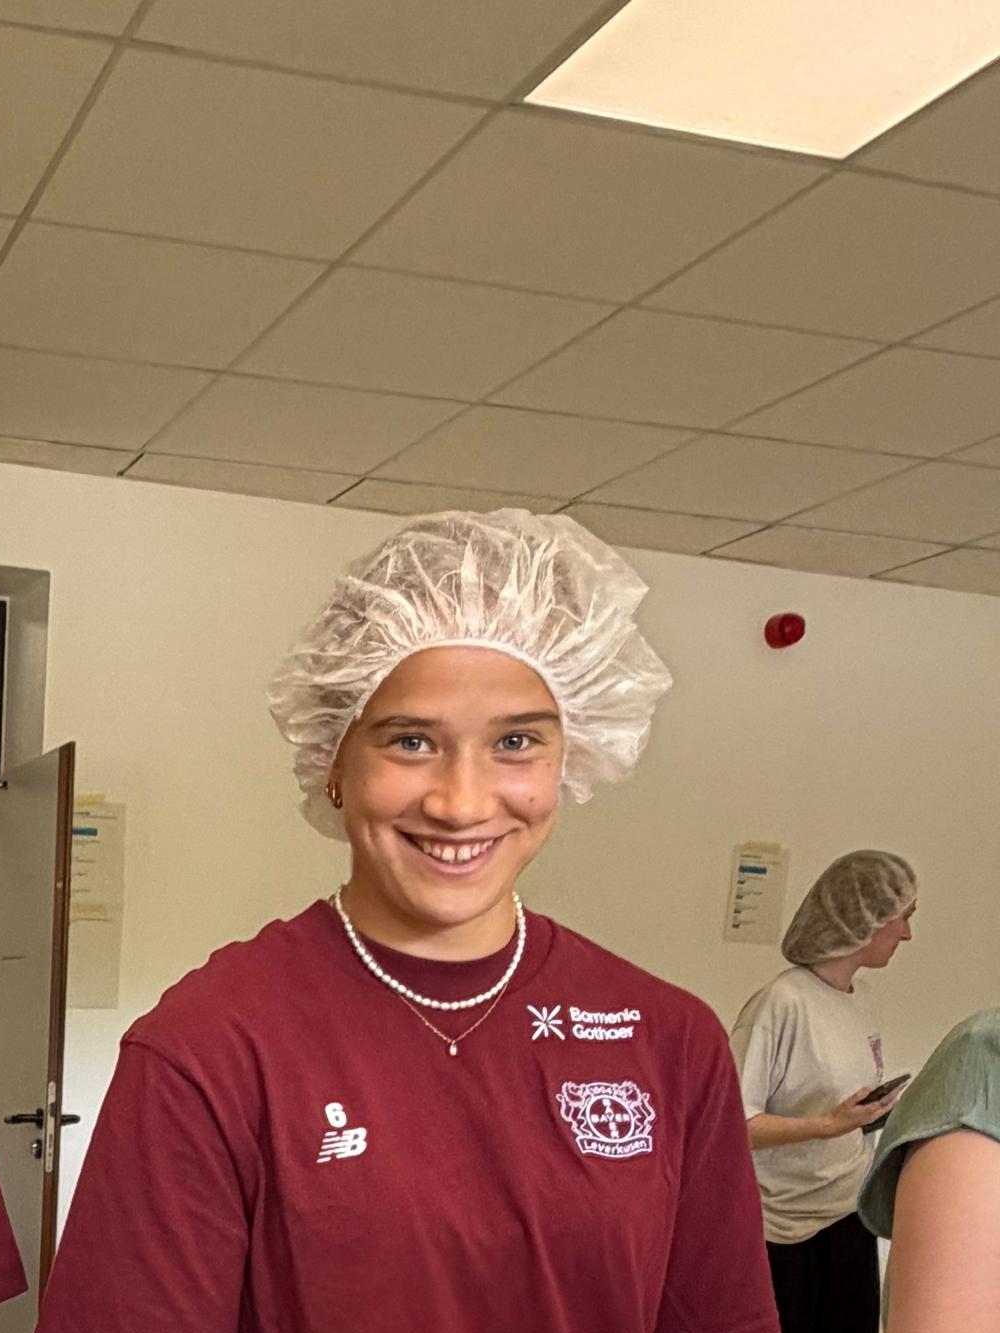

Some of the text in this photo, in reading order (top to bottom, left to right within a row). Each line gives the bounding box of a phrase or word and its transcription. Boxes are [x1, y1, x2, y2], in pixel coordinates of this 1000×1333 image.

[572, 1024, 634, 1040] Gothaer
[325, 1102, 347, 1128] 6
[584, 1138, 648, 1155] Leverkusen
